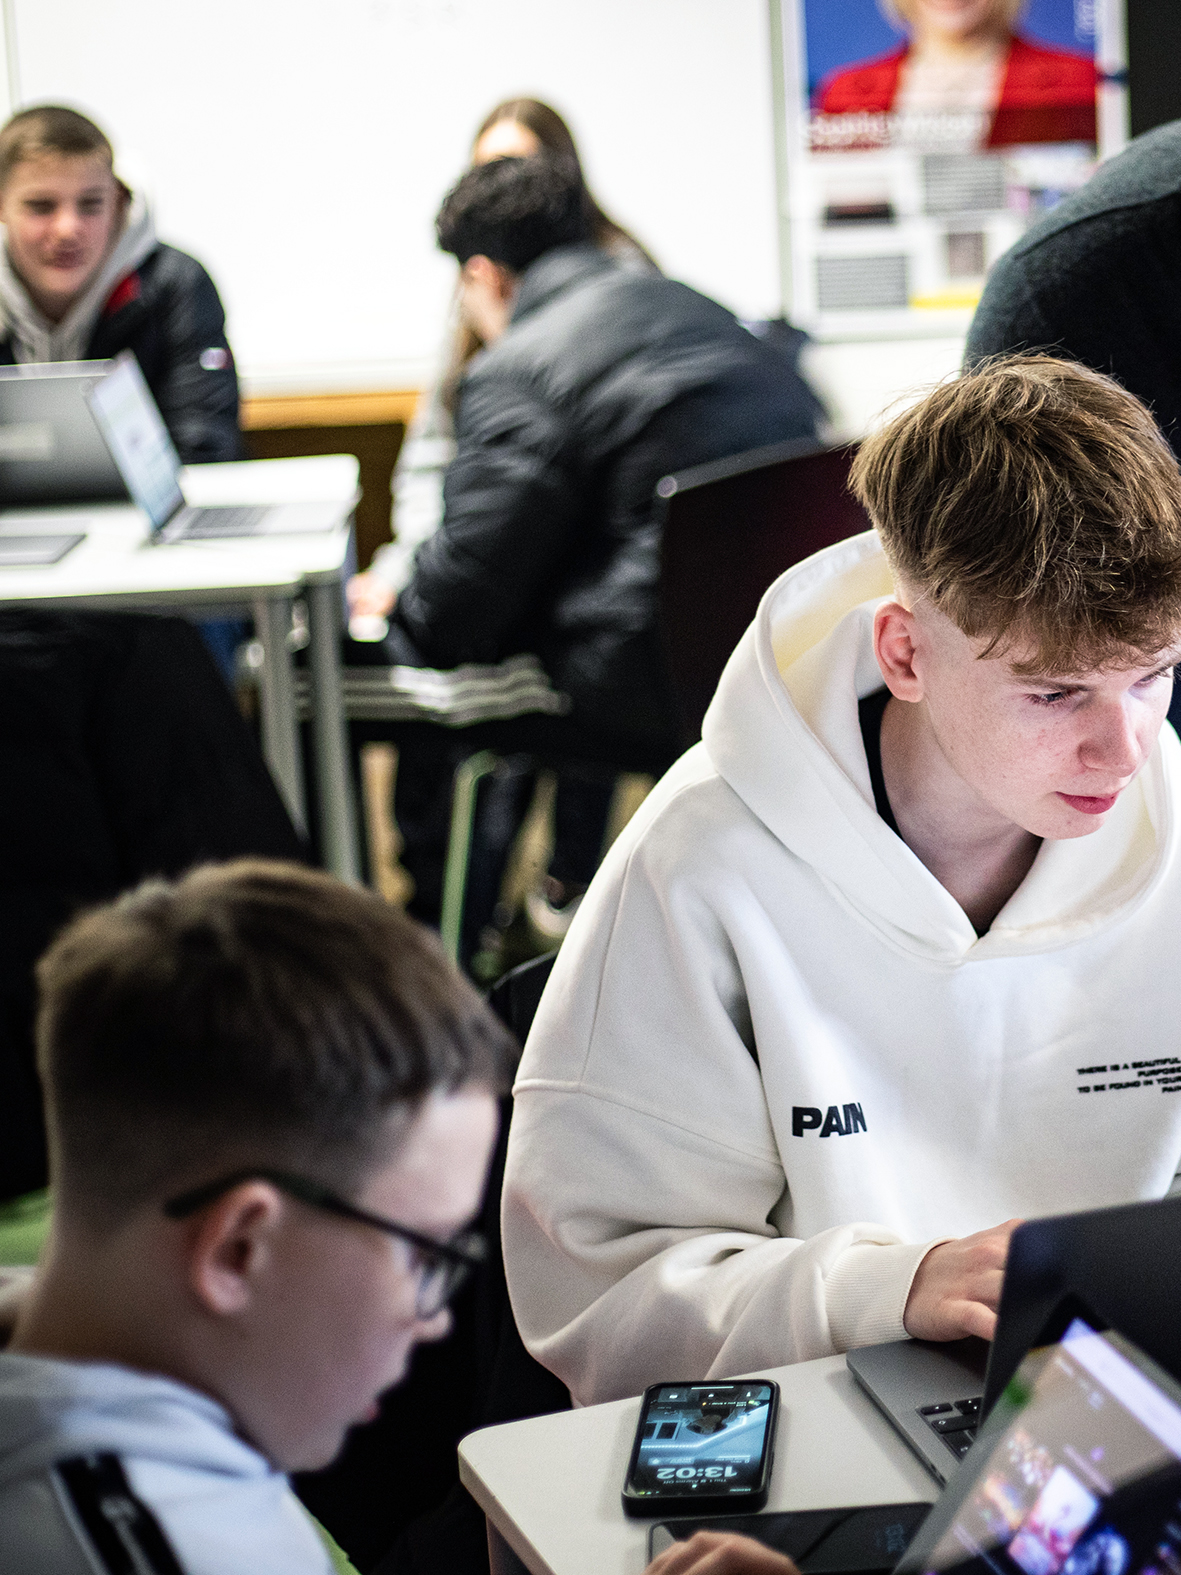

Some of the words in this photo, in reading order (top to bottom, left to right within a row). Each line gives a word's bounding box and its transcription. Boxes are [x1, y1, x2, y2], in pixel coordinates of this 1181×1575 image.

[1077, 1066, 1107, 1075] THERE
[1131, 1057, 1181, 1069] BEAUTIFUL
[1137, 1066, 1181, 1077] PURPOSE
[1093, 1084, 1106, 1092] BE
[1109, 1080, 1141, 1090] FOUND
[792, 1102, 867, 1138] PAIN
[656, 1466, 738, 1479] 13:02
